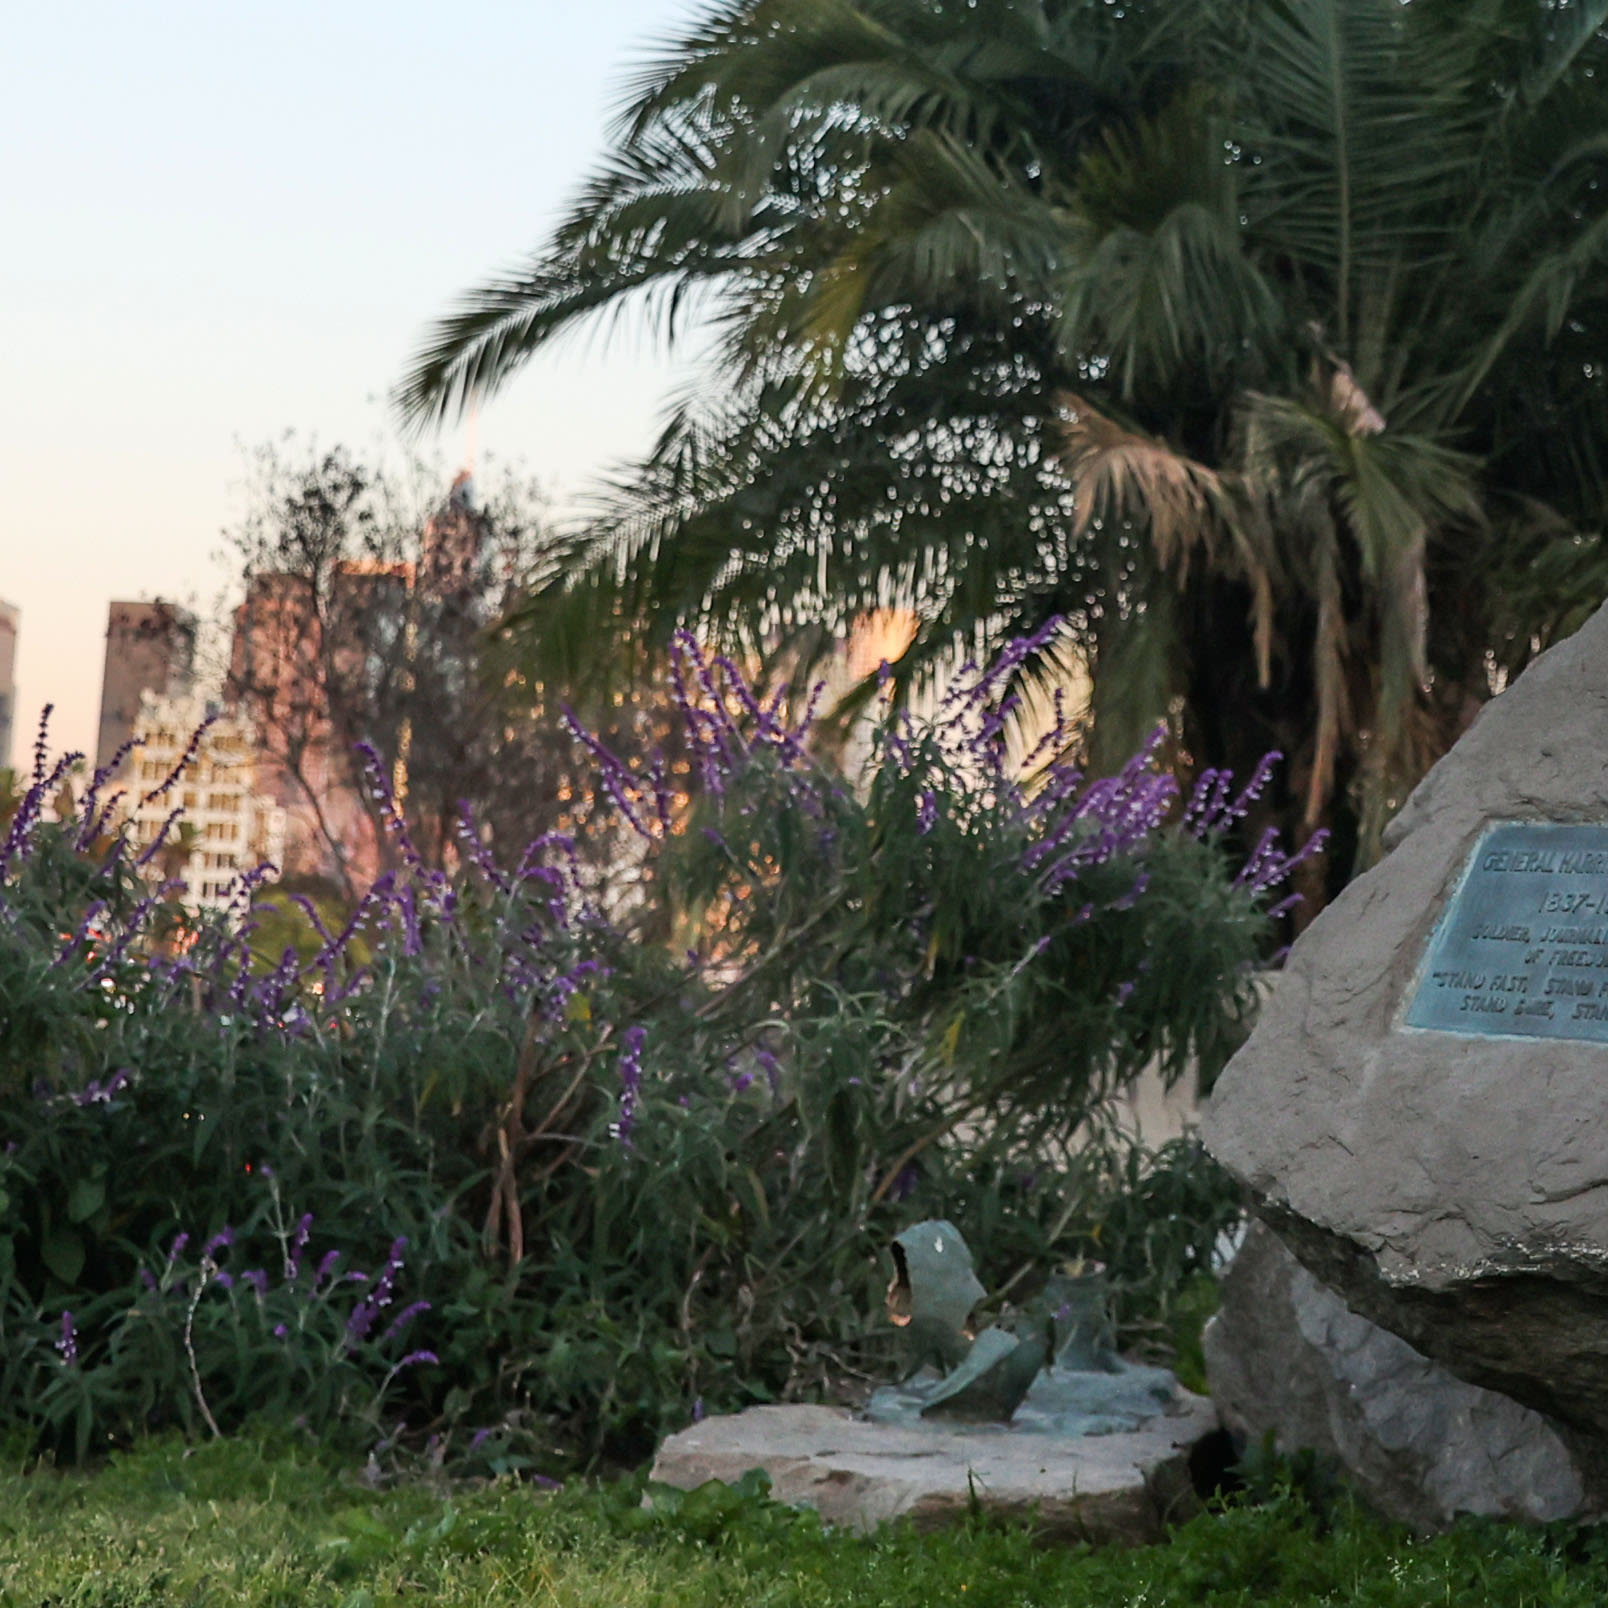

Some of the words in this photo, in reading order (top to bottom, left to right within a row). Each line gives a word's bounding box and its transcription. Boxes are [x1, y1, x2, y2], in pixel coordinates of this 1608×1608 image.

[1482, 851, 1554, 873] GENERAL
[1472, 925, 1530, 943] SOLDIER,
[1524, 949, 1545, 965] OF
[1544, 978, 1592, 997] STAND
[1460, 995, 1509, 1014] STAND
